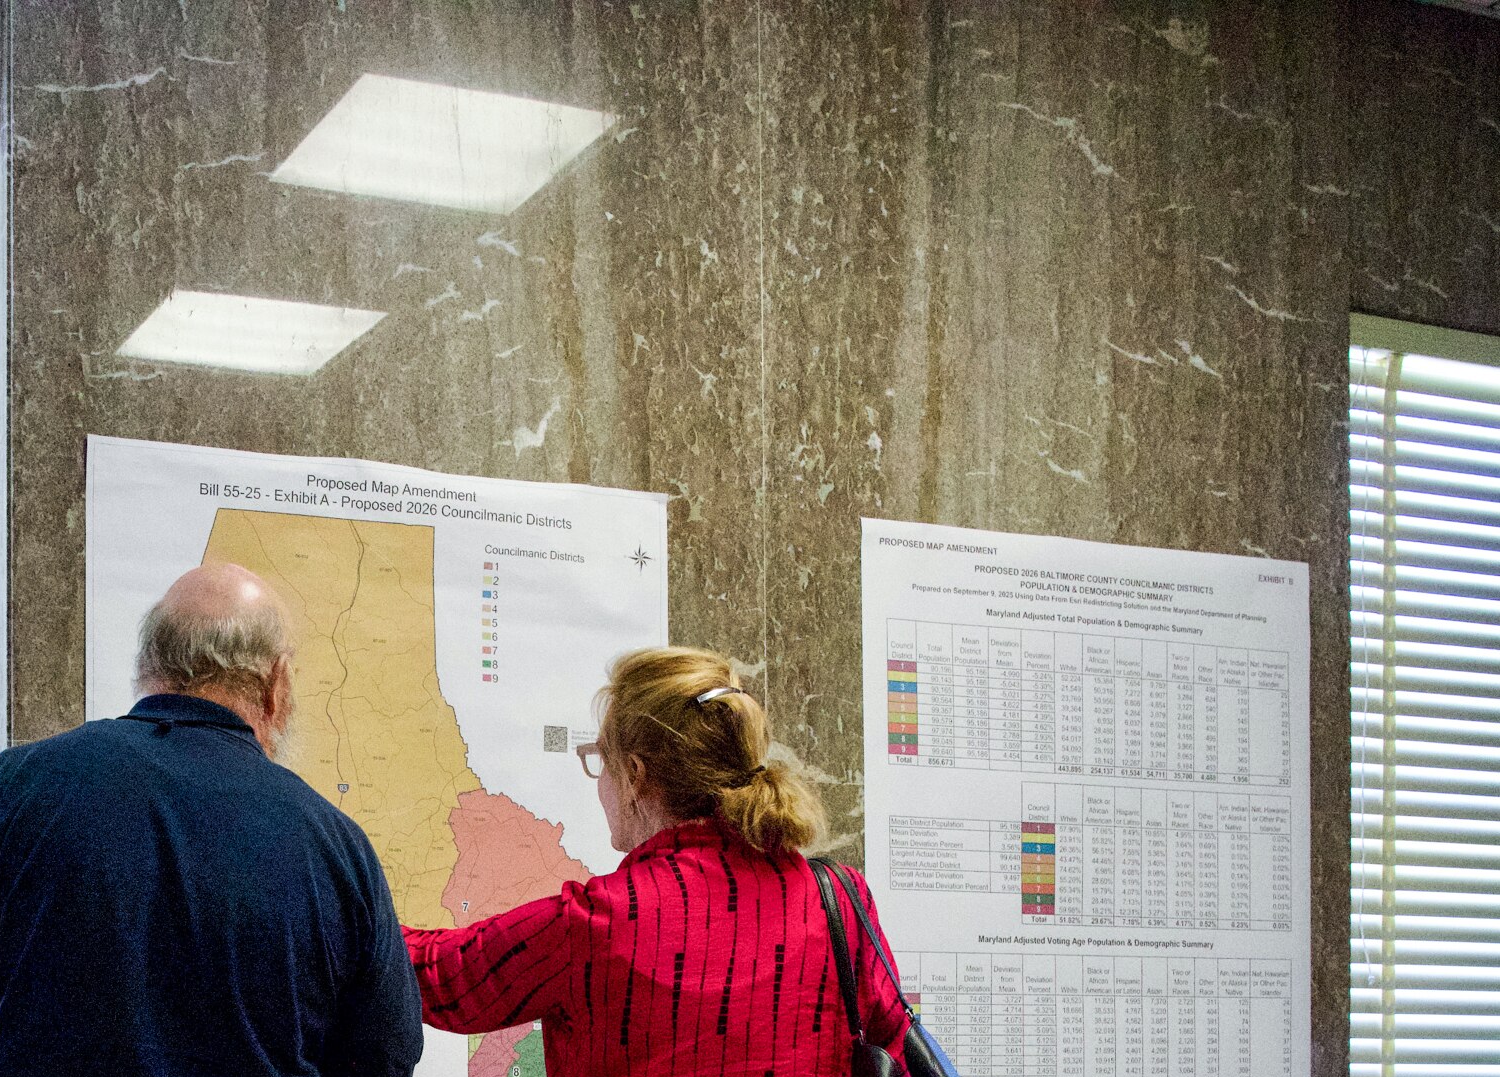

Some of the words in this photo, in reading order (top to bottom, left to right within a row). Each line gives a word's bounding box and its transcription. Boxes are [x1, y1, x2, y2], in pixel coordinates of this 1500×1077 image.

[306, 474, 367, 492] Proposed
[372, 481, 399, 496] Map
[402, 484, 477, 502] Amendment
[200, 483, 219, 497] Bill
[223, 485, 261, 500] 55-25
[274, 489, 317, 506] Exhibit
[320, 494, 329, 506] A
[342, 495, 402, 513] Proposed
[406, 501, 437, 516] 2026
[441, 505, 523, 524] Councilmanic
[526, 513, 572, 530] Districts
[879, 537, 925, 549] PROPOSED
[926, 542, 944, 551] MAP
[946, 544, 998, 556] AMENDMENT
[484, 544, 548, 560] Councilmanic
[550, 550, 585, 564] Districts
[495, 562, 499, 571] 1
[493, 576, 500, 586] 2
[974, 565, 1019, 576] PROPOSED
[1021, 569, 1038, 578] 2026
[1040, 571, 1085, 583] BALTIMORE
[1087, 575, 1118, 586] COUNTY
[1119, 578, 1175, 591] COUNCILMANIC
[1177, 583, 1214, 595] DISTRICTS
[1258, 574, 1285, 584] EXHIBIT
[492, 591, 499, 600] 3
[1020, 581, 1070, 593] POPULATION
[1079, 586, 1136, 598] DEMOGRAPHIC
[1137, 590, 1174, 603] SUMMARY
[912, 584, 941, 594] Prepared
[953, 587, 989, 598] September
[998, 591, 1014, 599] 2025
[1015, 592, 1034, 601] Using
[1035, 593, 1050, 601] Data
[1052, 594, 1068, 604] From
[1083, 597, 1122, 609] Redistricting
[1124, 601, 1149, 611] Solution
[1173, 606, 1200, 616] Maryland
[1201, 609, 1234, 619] Department
[1241, 612, 1267, 623] Planning
[492, 605, 498, 613] 4
[492, 619, 498, 628] 5
[986, 609, 1021, 619] Maryland
[1022, 611, 1055, 621] Adjusted
[1057, 613, 1075, 624] Total
[1077, 616, 1116, 629] Population
[1117, 619, 1123, 627] &
[1124, 620, 1170, 633] Demographic
[1172, 624, 1204, 636] Summary
[492, 632, 498, 641] 6
[961, 637, 980, 645] Mean
[891, 641, 914, 650] Council
[990, 638, 1019, 648] Deviation
[492, 646, 498, 655] 7
[927, 644, 943, 652] Total
[959, 647, 982, 656] District
[892, 652, 913, 660] District
[918, 653, 951, 663] Population
[998, 650, 1013, 658] from
[1024, 651, 1052, 660] Deviation
[492, 660, 498, 669] 8
[954, 656, 987, 667] Population
[996, 659, 1014, 668] Mean
[1027, 662, 1050, 670] Percent
[492, 674, 498, 683] 9
[896, 756, 912, 764] Total
[891, 818, 908, 826] Mean
[910, 829, 938, 837] Deviation
[910, 840, 938, 848] Deviation
[939, 841, 963, 849] Percent
[891, 850, 915, 858] Largest
[935, 851, 957, 859] District
[891, 860, 918, 868] Smallest
[891, 870, 914, 878] Overall
[914, 871, 934, 879] Actual
[935, 872, 964, 880] Deviation
[915, 881, 934, 889] Actual
[935, 882, 964, 890] Deviation
[965, 883, 989, 891] Percent
[462, 902, 470, 913] 7
[978, 935, 1012, 945] Maryland
[1013, 936, 1045, 946] Adjusted
[1047, 937, 1071, 947] Voting
[1072, 938, 1086, 947] Age
[1087, 938, 1126, 948] Population
[1127, 939, 1133, 947] &
[1134, 939, 1180, 949] Demographic
[1182, 940, 1214, 950] Summary
[513, 1067, 520, 1077] 8
